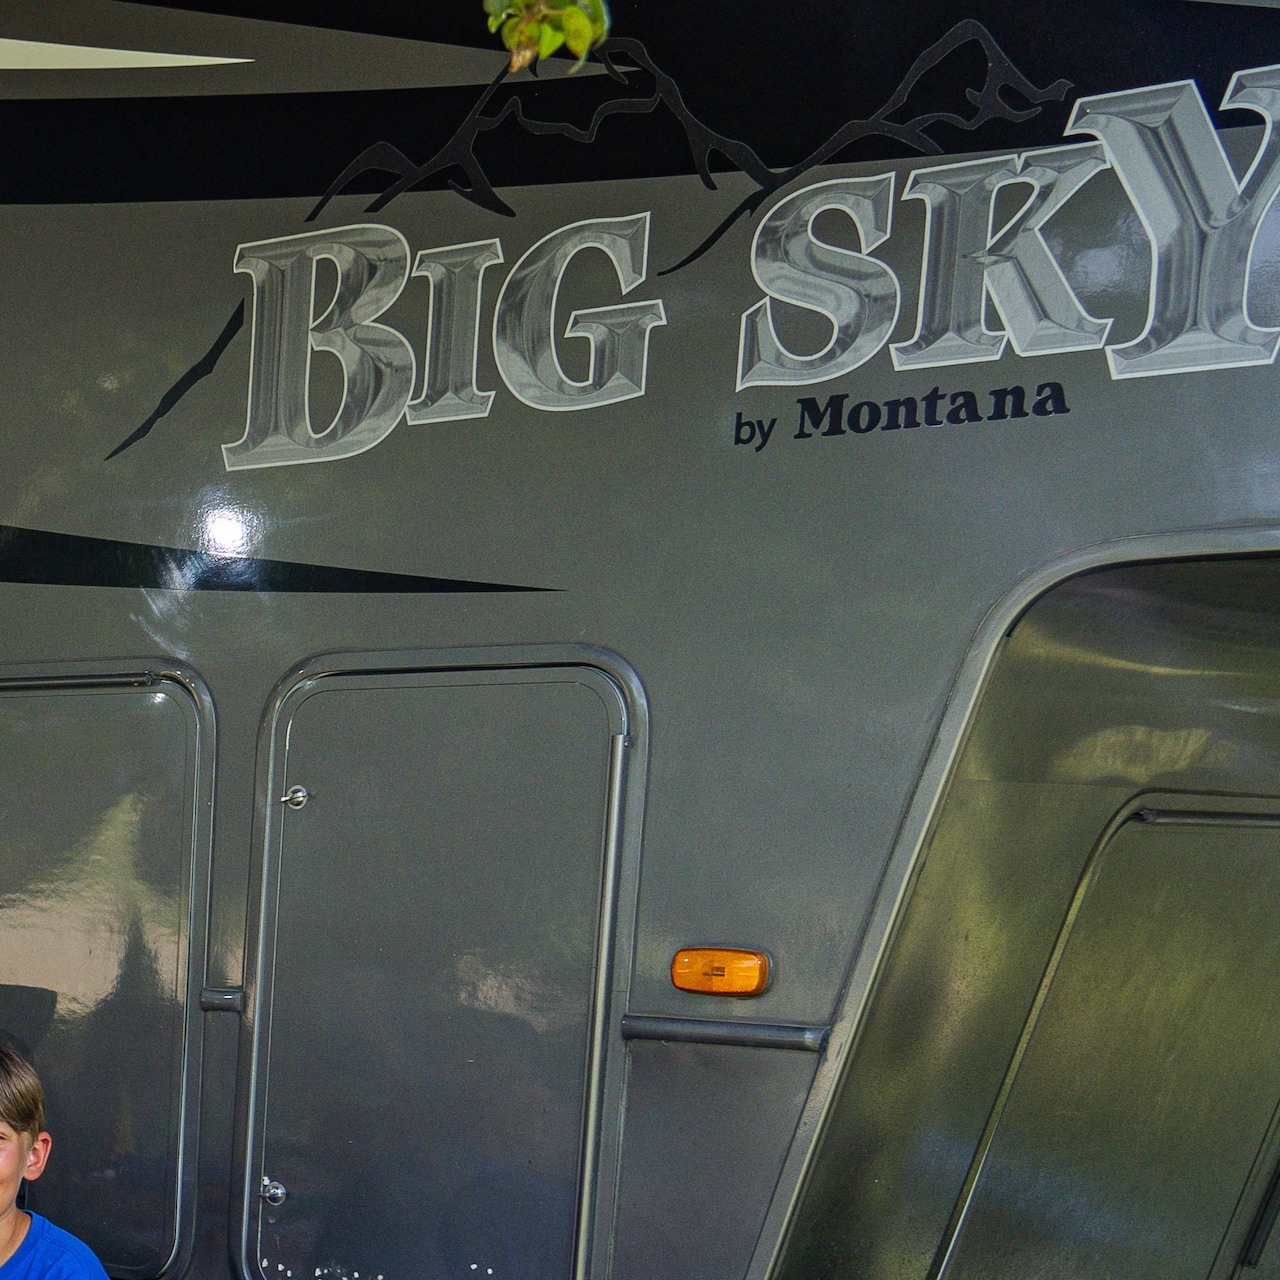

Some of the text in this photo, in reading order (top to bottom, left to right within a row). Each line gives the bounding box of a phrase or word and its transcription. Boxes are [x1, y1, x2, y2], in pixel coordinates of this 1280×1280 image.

[222, 64, 1280, 471] BIG SKY
[733, 381, 1071, 452] by Montana
